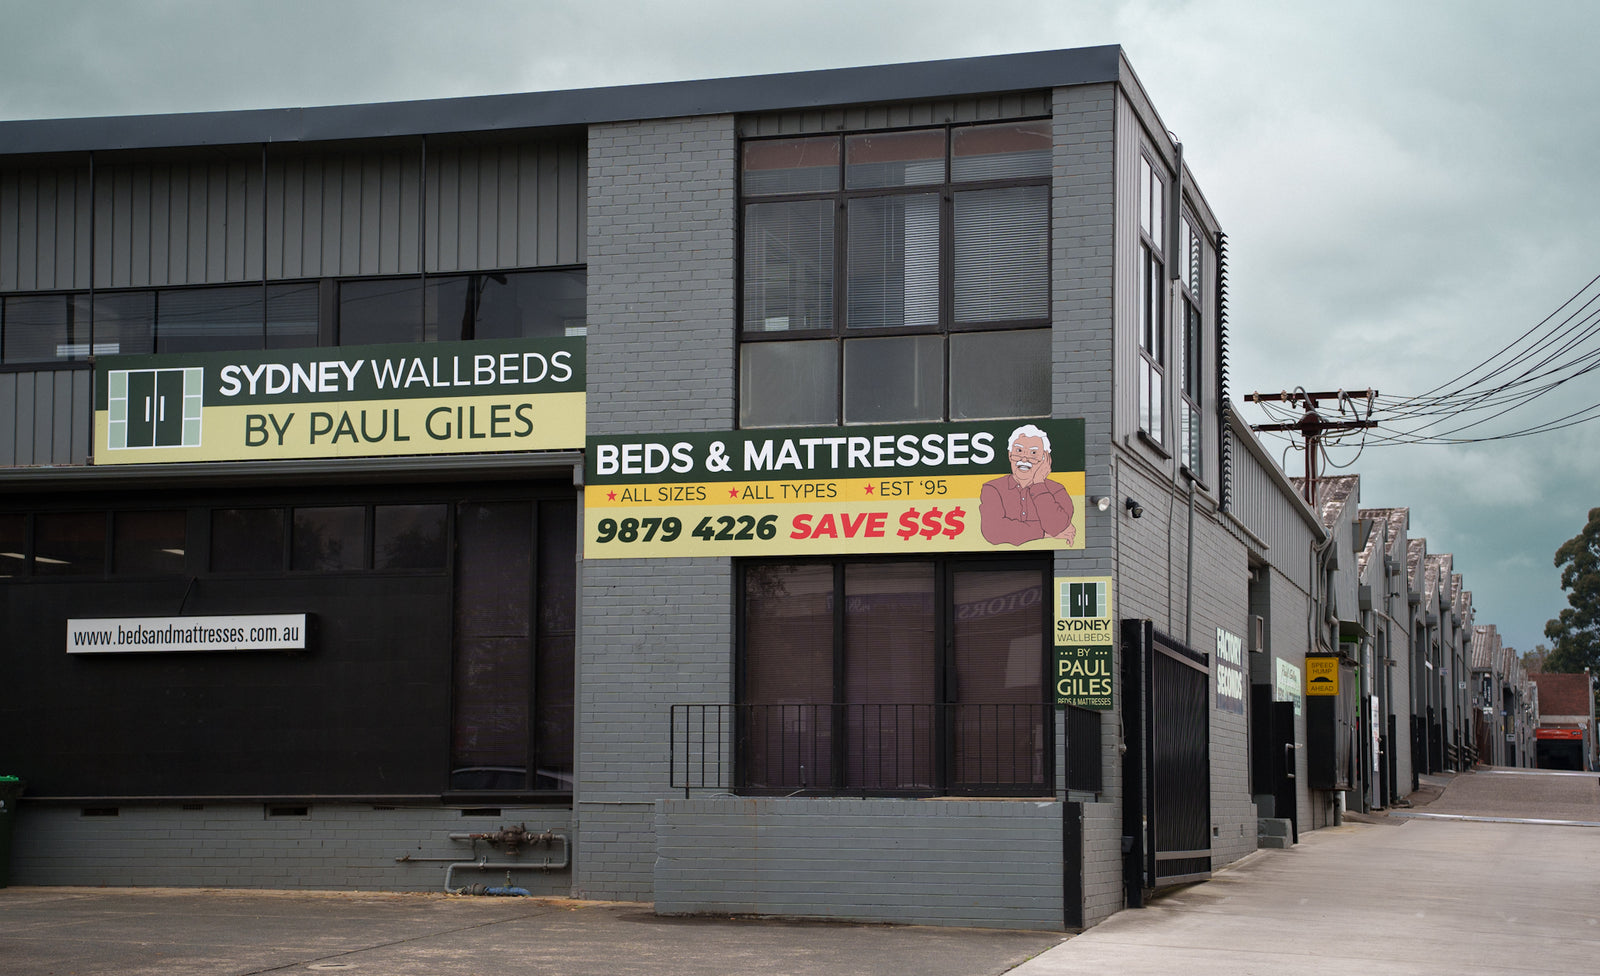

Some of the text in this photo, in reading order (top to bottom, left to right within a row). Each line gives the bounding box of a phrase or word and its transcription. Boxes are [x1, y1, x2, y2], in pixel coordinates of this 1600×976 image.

[219, 351, 573, 396] SYDNEY WALLBEDS
[245, 403, 534, 447] BY PAUL GILES
[596, 432, 995, 476] BEDS & MATTRESSES
[620, 488, 652, 502] ALL
[657, 486, 706, 501] SIZES
[742, 485, 773, 500] ALL
[780, 484, 837, 500] TYPES
[880, 482, 912, 496] EST
[596, 506, 966, 544] 9879 4226 SAVE $$$
[73, 624, 299, 646] www.bedsandmattresses.com.au
[1057, 620, 1110, 631] SYDNEY
[1057, 633, 1110, 642] WALLBEDS
[1216, 627, 1242, 666] FACTORY
[1077, 648, 1090, 656] BY
[1059, 660, 1110, 676] PAUL
[1057, 679, 1112, 695] GILES
[1217, 664, 1242, 700] SECONDS
